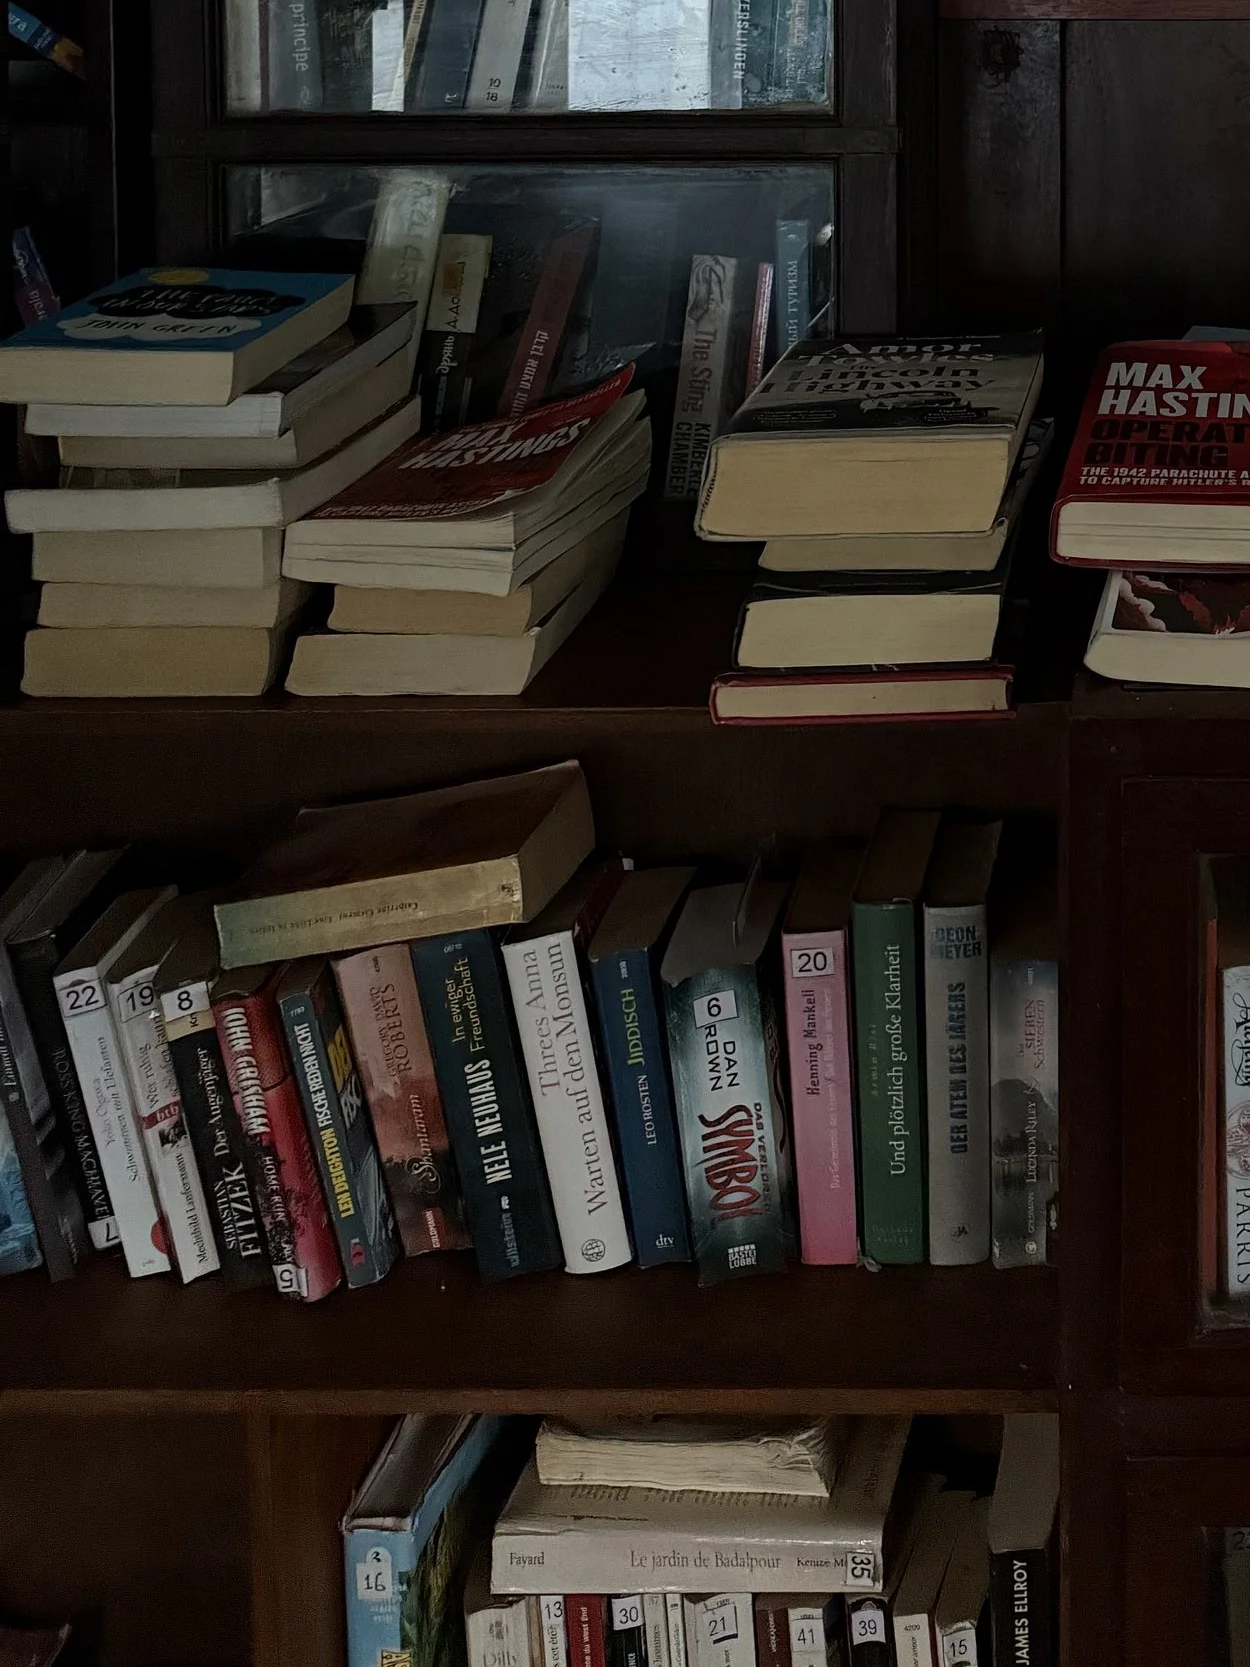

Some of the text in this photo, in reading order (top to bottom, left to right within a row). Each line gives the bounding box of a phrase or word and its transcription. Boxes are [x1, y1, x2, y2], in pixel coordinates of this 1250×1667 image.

[289, 3, 311, 71] principe
[787, 260, 799, 314] ТУРИЗМ
[691, 329, 718, 362] The
[787, 366, 980, 381] Lincoln
[1104, 361, 1208, 390] MAX
[397, 417, 592, 471] HASTINGS
[1083, 442, 1230, 468] BITING
[1101, 476, 1170, 486] CAPTURE
[1171, 477, 1237, 486] HITLER'S
[1113, 467, 1147, 478] 1942
[1150, 468, 1237, 478] PARACHUTE
[934, 925, 976, 944] DEON
[797, 952, 827, 974] 20
[66, 985, 98, 1011] 22
[125, 986, 156, 1011] 19
[177, 990, 194, 1011] 8
[444, 978, 463, 1026] ewiger
[456, 957, 487, 1053] Freundschaft
[706, 996, 723, 1018] 6
[379, 983, 412, 1074] ROBERTS
[521, 949, 562, 1096] Threes Anna
[619, 988, 646, 1067] JIDDISCH
[802, 988, 824, 1096] Henning Mankell
[221, 1006, 272, 1135] JOHN GRISHAM
[547, 942, 609, 1216] Warten auf den Monsun
[722, 1040, 740, 1087] DAN
[883, 943, 910, 1175] Und plötzlich große Klarheit
[946, 983, 968, 1154] DER ATEM DES JÄGERS
[196, 1047, 230, 1157] Der Augenjäger
[293, 1022, 355, 1219] LEN DEIGHTON FISCHE REDEN NICHT
[464, 1058, 513, 1185] NELE NEUHAUS
[637, 1074, 658, 1146] LEO ROSTEN
[407, 1094, 438, 1183] Shantaram
[1024, 1136, 1038, 1183] LUCINDA
[213, 1161, 263, 1259] SEBASTIAN FITZEK
[261, 1155, 286, 1222] HOME RUN
[364, 1573, 386, 1592] 16
[509, 1550, 783, 1573] Fayard Le jardin de Badalpour
[852, 1553, 873, 1581] 35
[545, 1600, 564, 1620] 13
[1013, 1559, 1030, 1616] ELLROY
[618, 1606, 639, 1625] 30
[709, 1619, 728, 1637] 21
[797, 1627, 817, 1646] 41
[858, 1619, 879, 1638] 39
